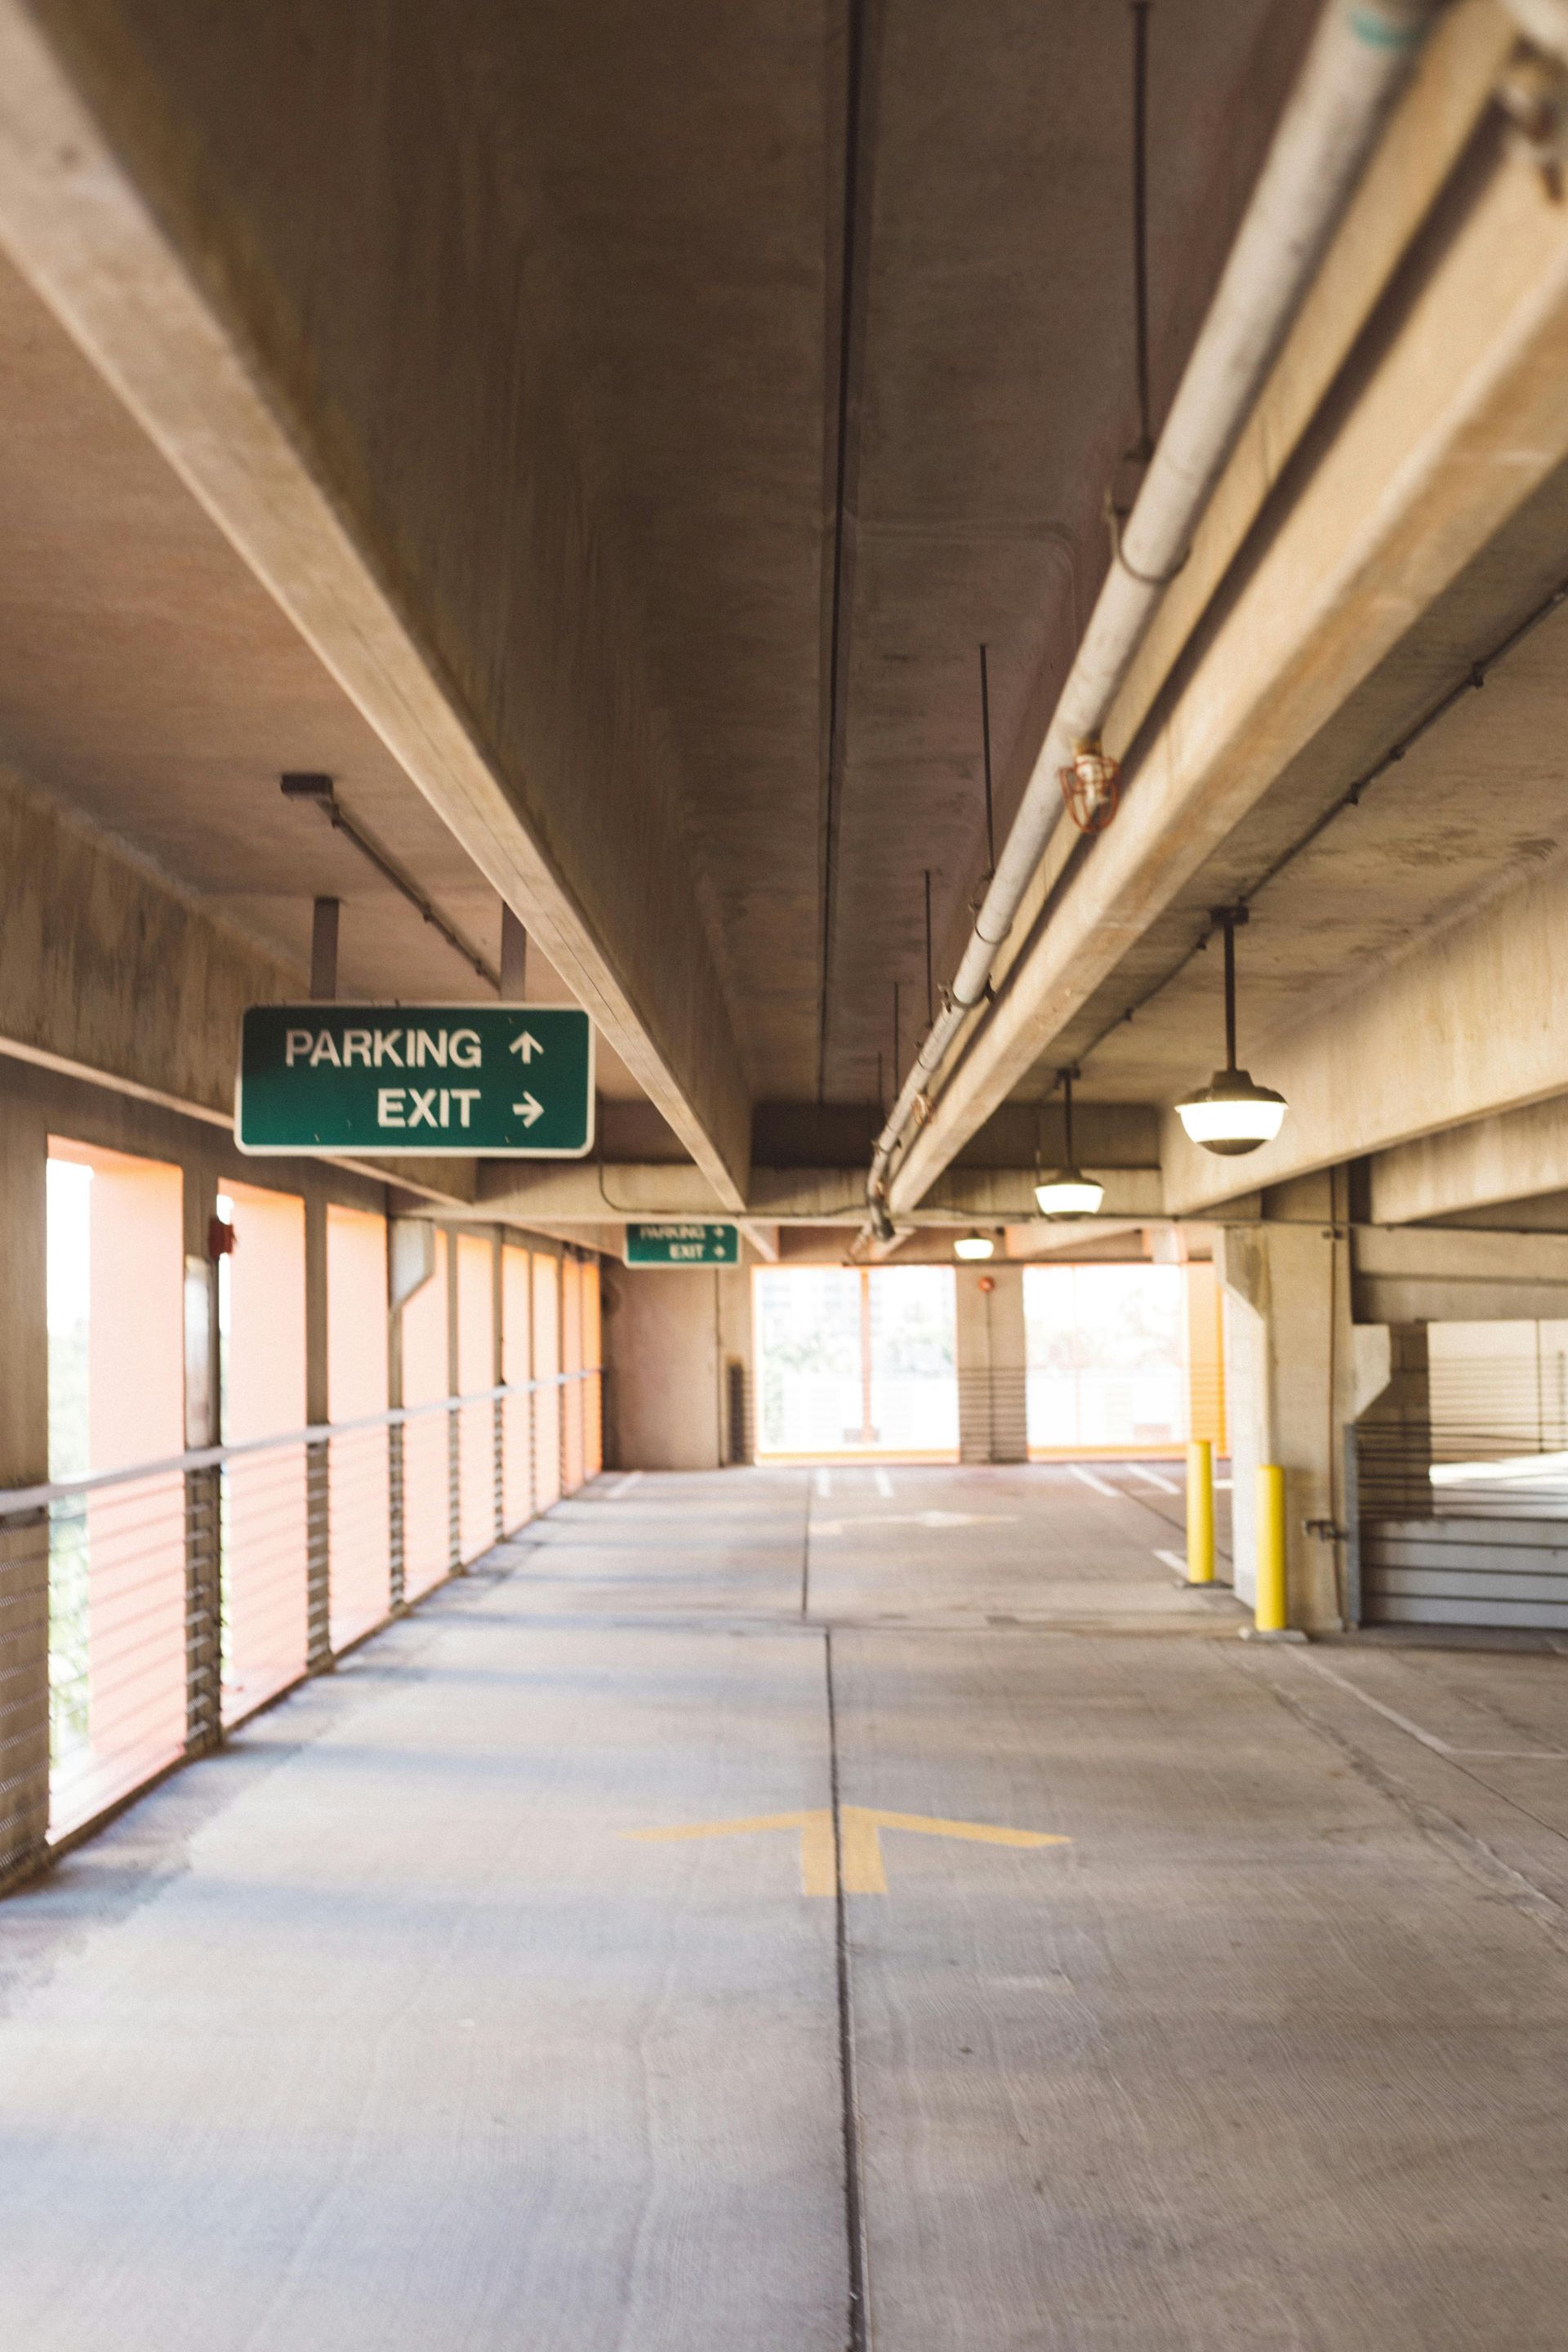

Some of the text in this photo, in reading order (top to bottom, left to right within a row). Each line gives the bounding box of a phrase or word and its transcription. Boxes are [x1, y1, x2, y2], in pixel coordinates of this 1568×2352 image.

[285, 1028, 482, 1068] PARKING
[377, 1088, 482, 1128] EXIT
[669, 1243, 704, 1259] EXIT
